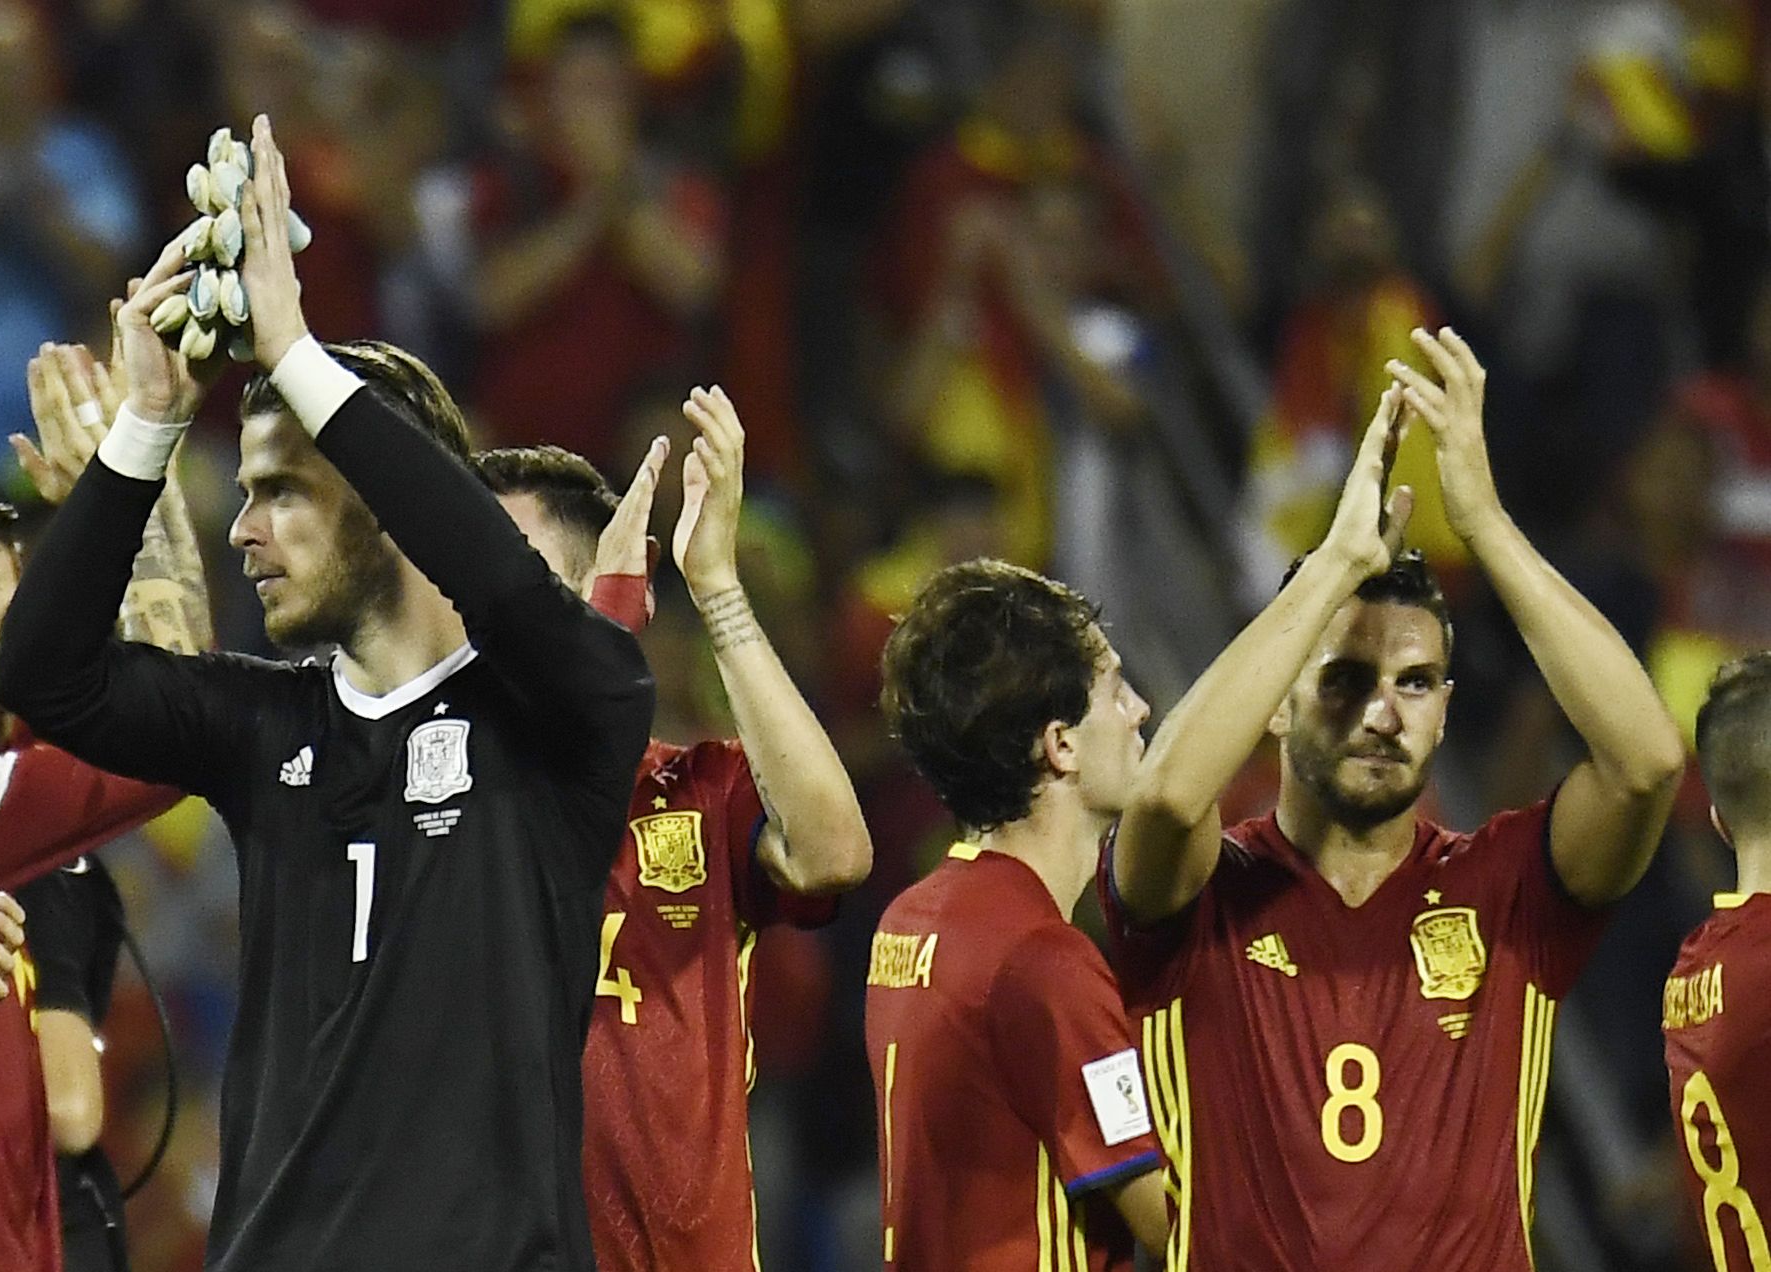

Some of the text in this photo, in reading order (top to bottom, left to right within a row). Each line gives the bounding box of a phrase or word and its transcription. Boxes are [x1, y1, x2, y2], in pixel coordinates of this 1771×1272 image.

[347, 843, 376, 963] 1
[595, 911, 643, 1025] 4
[1321, 1042, 1384, 1163] 8
